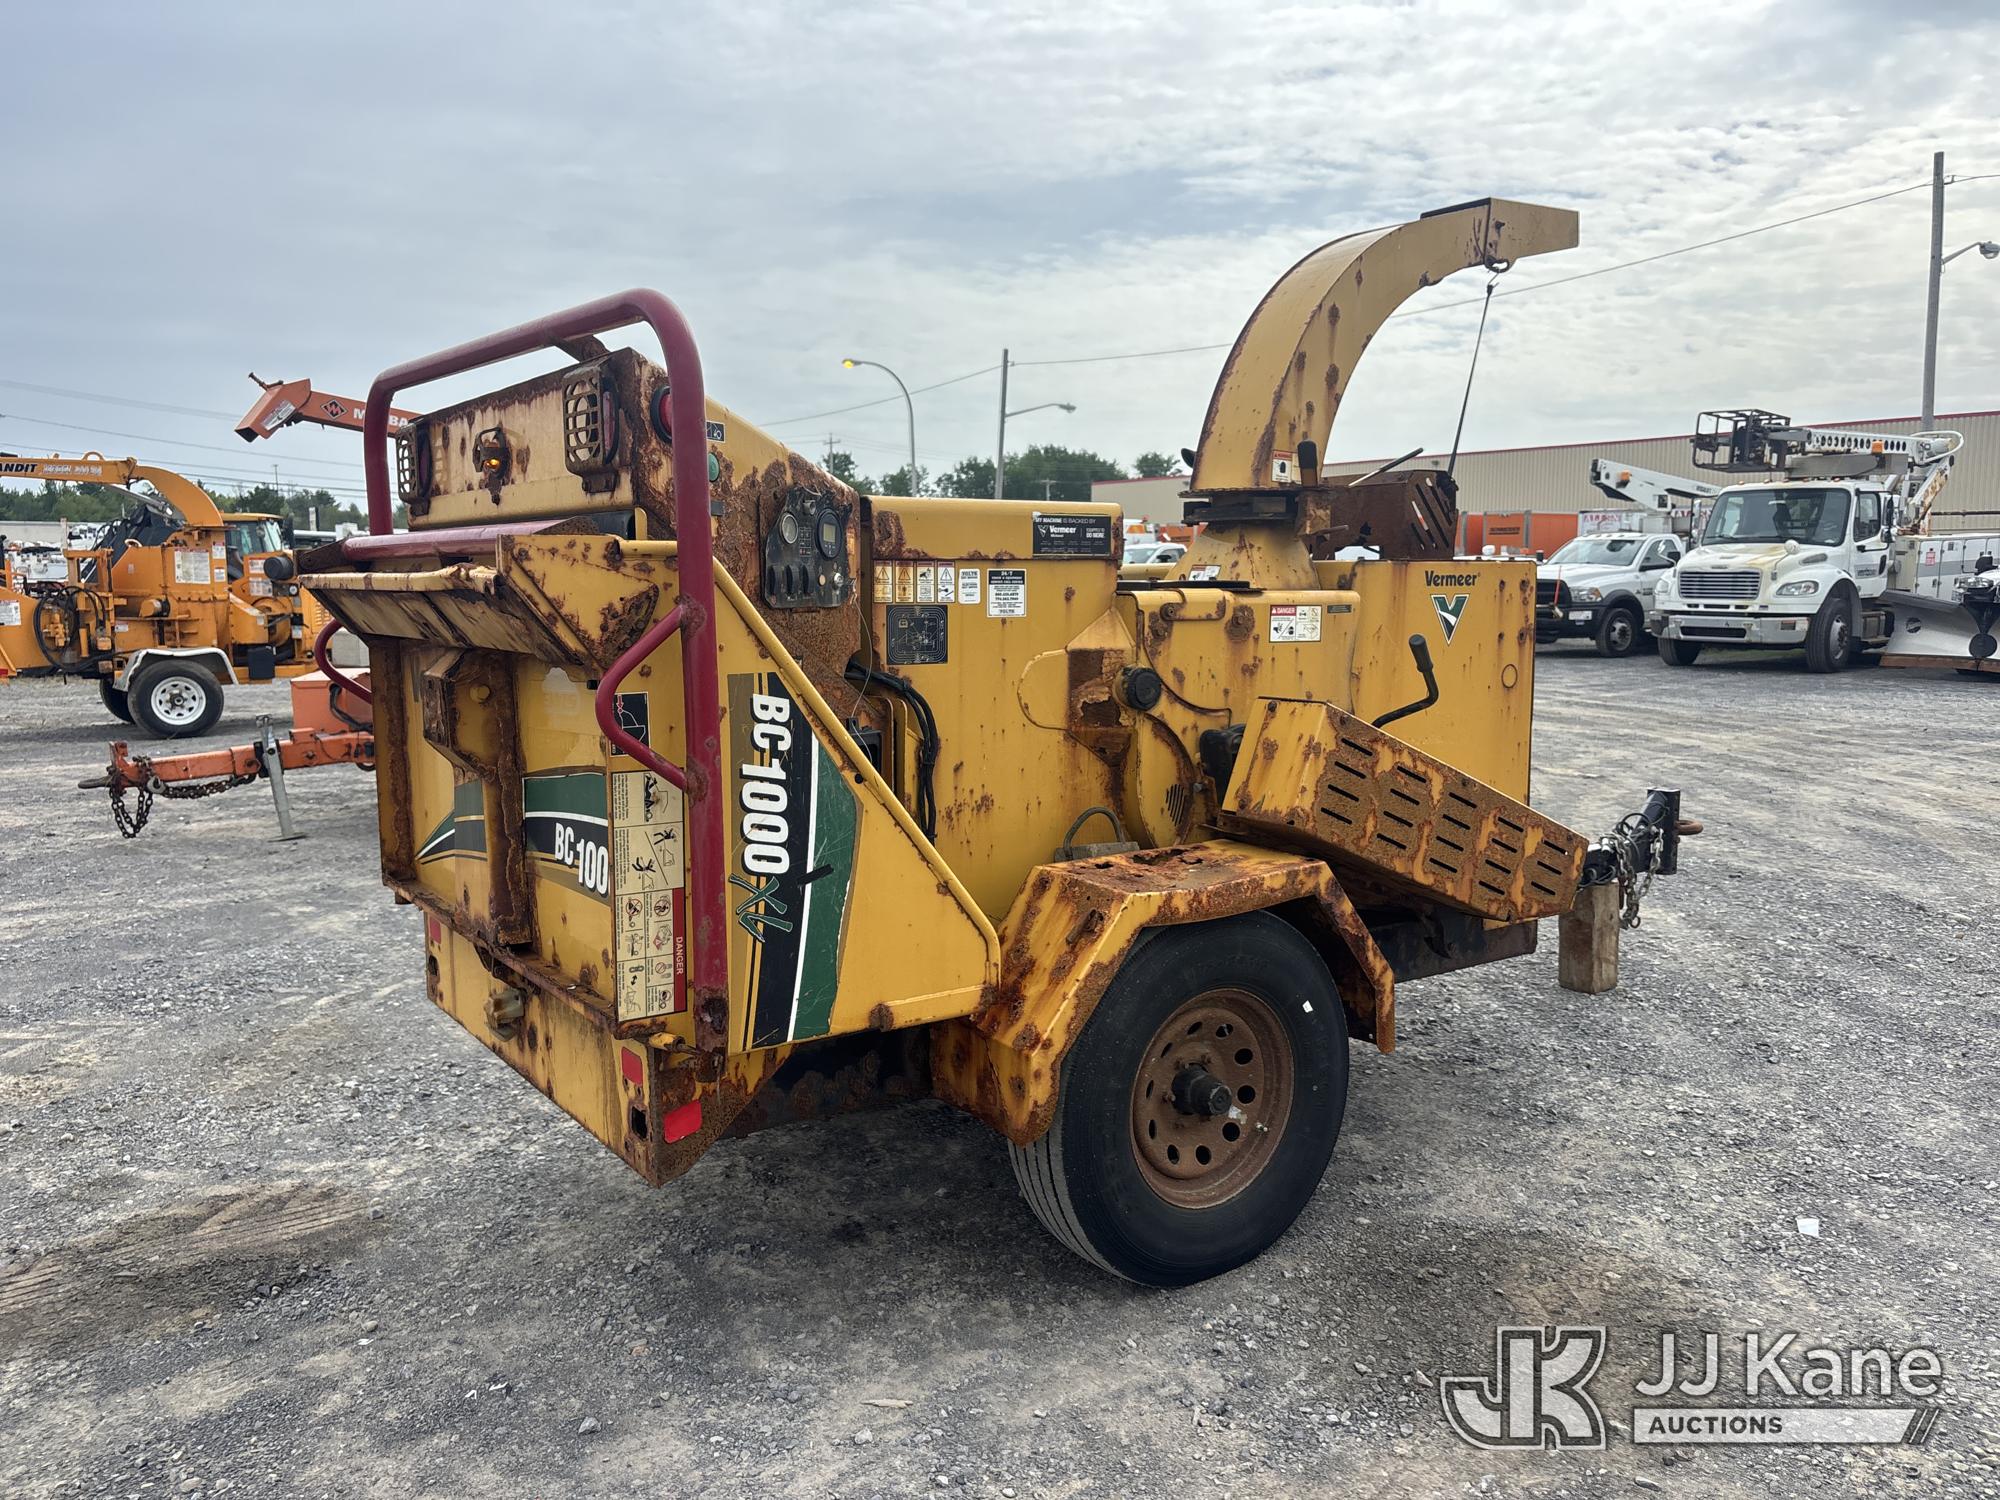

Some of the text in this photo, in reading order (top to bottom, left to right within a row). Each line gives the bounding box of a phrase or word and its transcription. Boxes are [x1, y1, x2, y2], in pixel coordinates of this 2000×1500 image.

[1049, 525, 1077, 534] Vermeer
[1425, 570, 1477, 587] Vermeer
[728, 873, 793, 942] XL
[675, 936, 684, 975] DANGER
